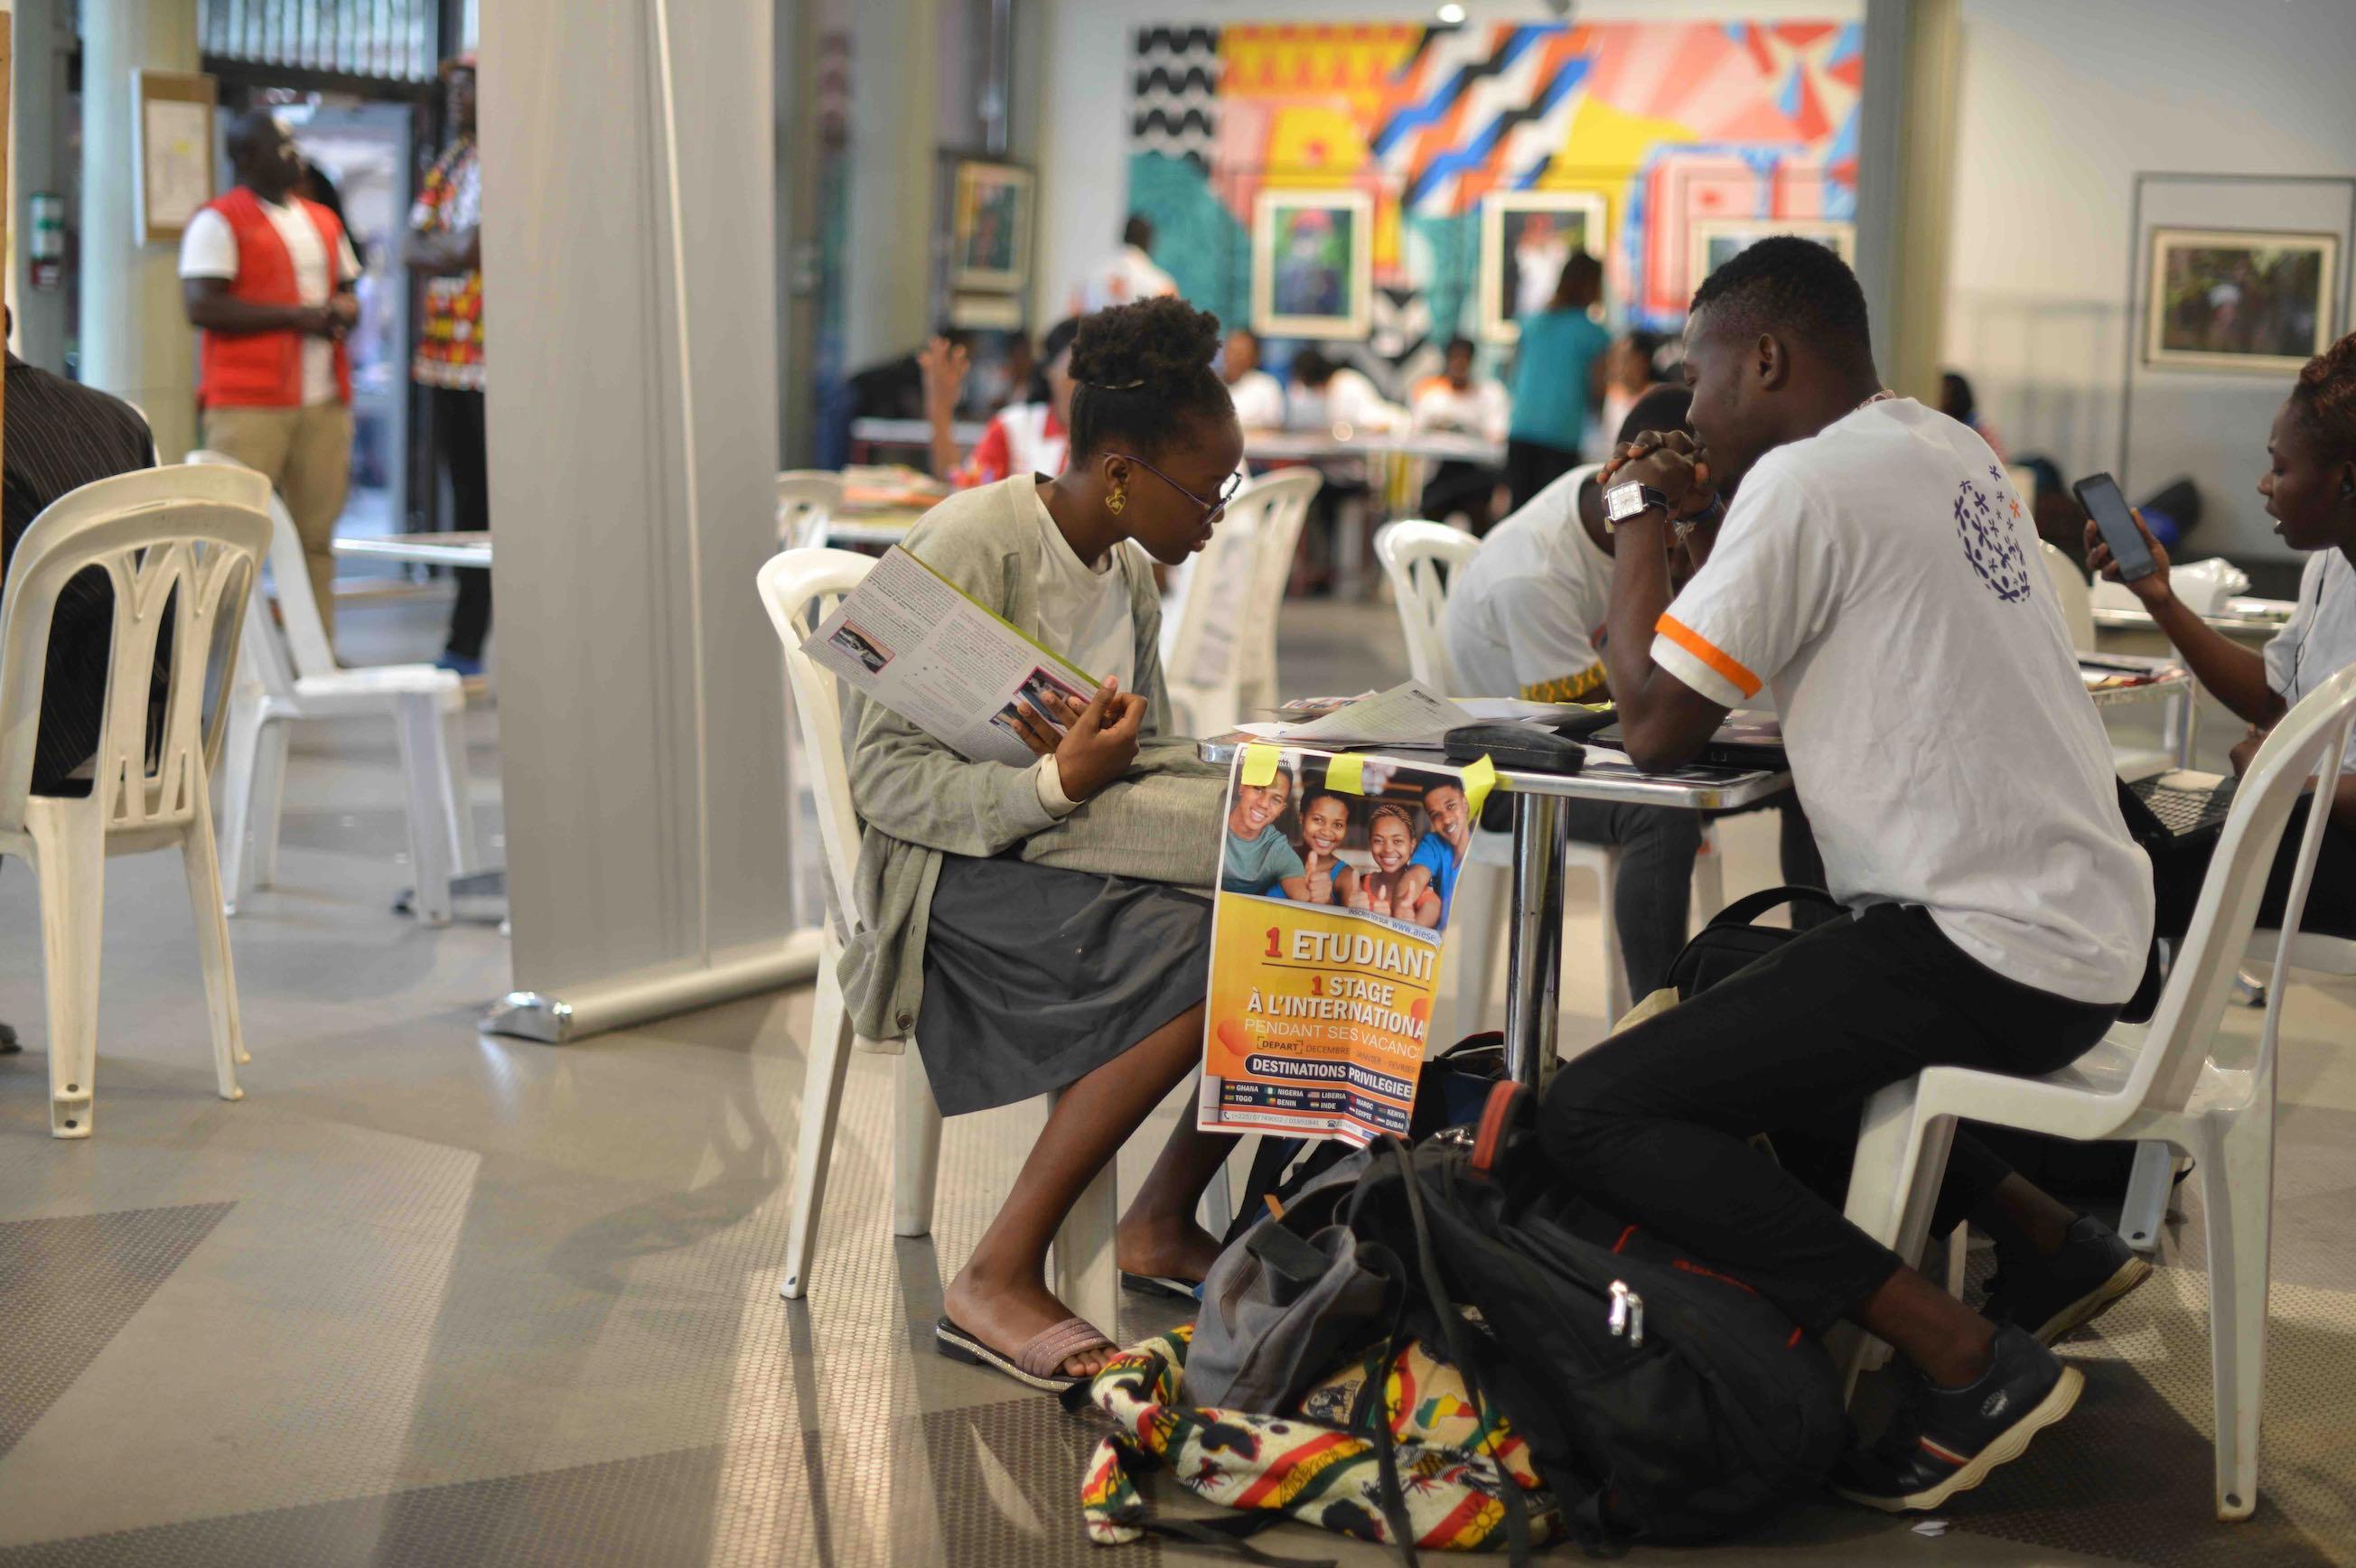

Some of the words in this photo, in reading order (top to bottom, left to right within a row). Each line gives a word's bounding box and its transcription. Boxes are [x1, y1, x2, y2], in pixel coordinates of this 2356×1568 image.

[1266, 927, 1282, 958] 1
[1292, 929, 1435, 982] ETUDIANT
[1247, 986, 1263, 1013] À
[1312, 975, 1324, 995] 1
[1329, 976, 1394, 1006] STAGE
[1244, 1019, 1323, 1038] PENDANT
[1327, 1025, 1359, 1041] SES
[1361, 1032, 1420, 1059] VACANC
[1252, 1058, 1346, 1078] DESTINATIONS
[1235, 1095, 1253, 1103] TOGO
[1276, 1098, 1296, 1106] BENIN
[1321, 1102, 1336, 1110] INDE
[1355, 1108, 1372, 1120] EGYPTE
[1385, 1119, 1404, 1130] DUBAI
[1236, 1084, 1258, 1093] GHANA
[1277, 1088, 1304, 1097] NIGERIA
[1322, 1091, 1346, 1099] LIBERIA
[1356, 1098, 1373, 1110] MAROC
[1387, 1108, 1406, 1119] KENYA
